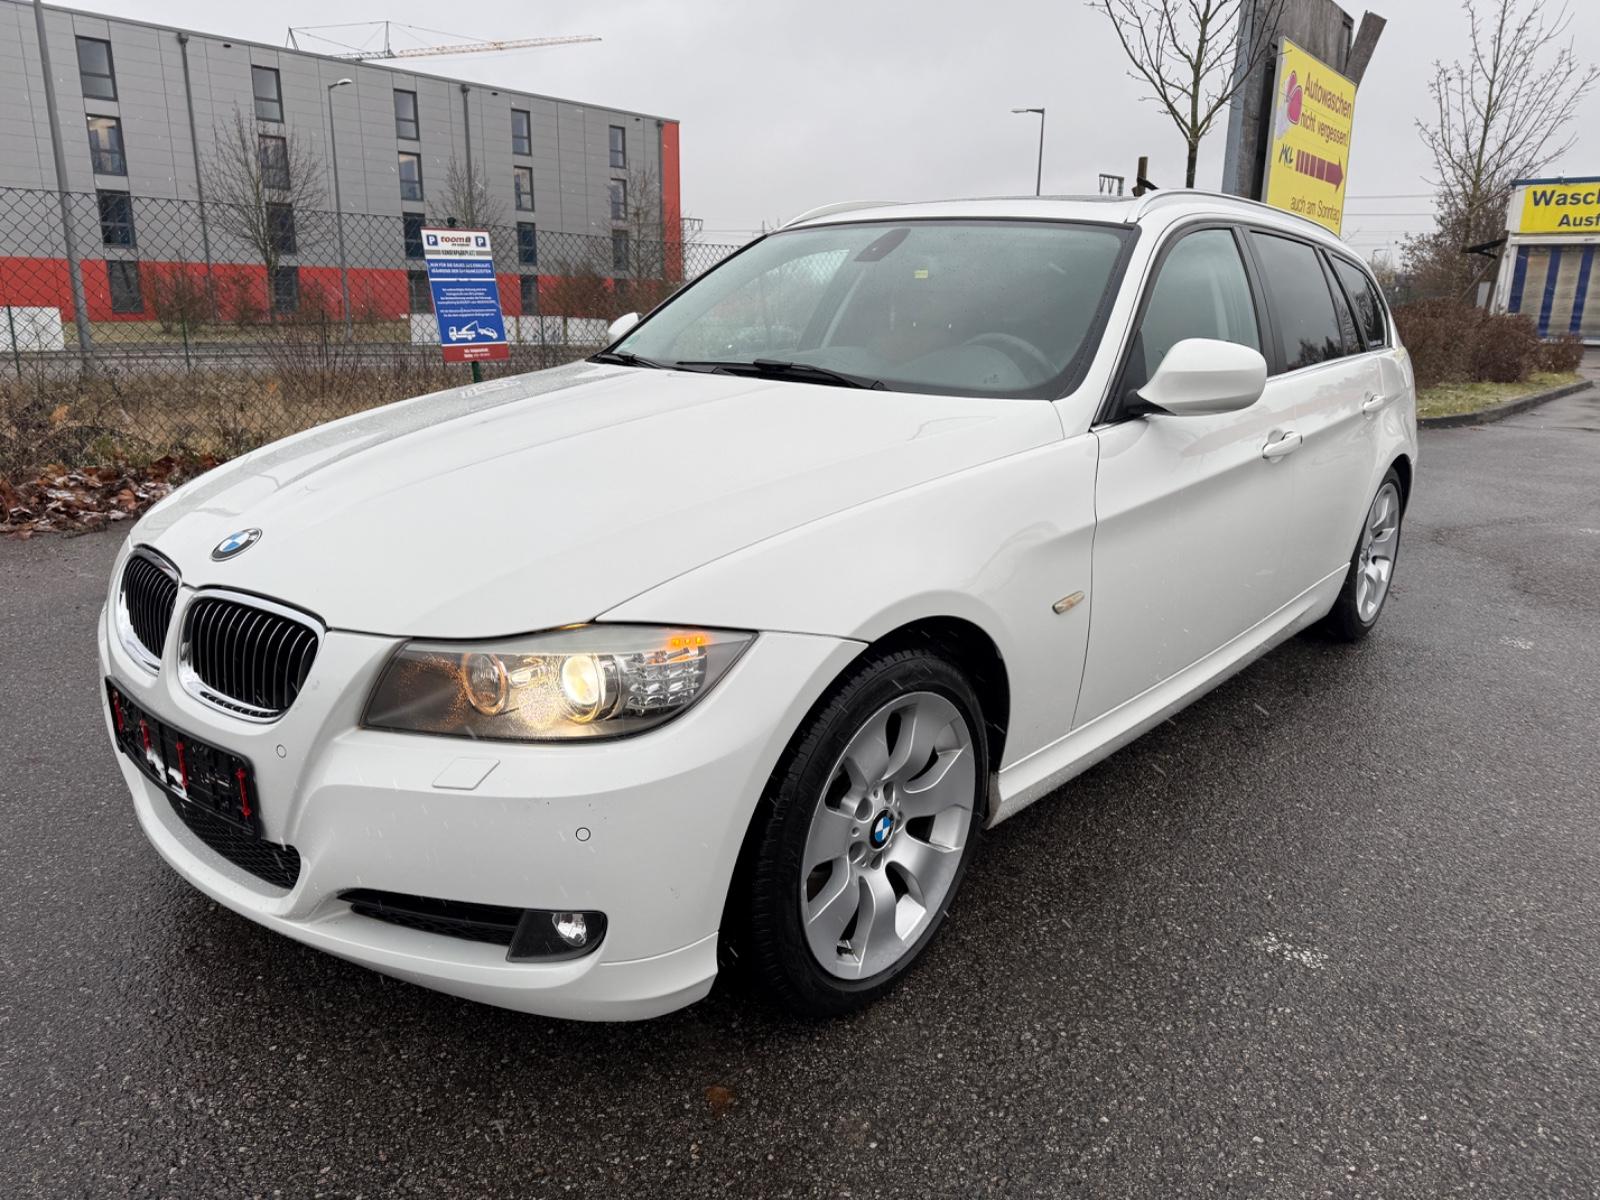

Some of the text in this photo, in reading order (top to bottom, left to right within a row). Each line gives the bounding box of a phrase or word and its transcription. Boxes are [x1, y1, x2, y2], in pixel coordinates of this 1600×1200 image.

[1304, 72, 1352, 119] Autowaschen
[1301, 110, 1316, 132] nicht
[1532, 188, 1600, 207] Wasc
[1290, 196, 1340, 225] auch am Sonntag
